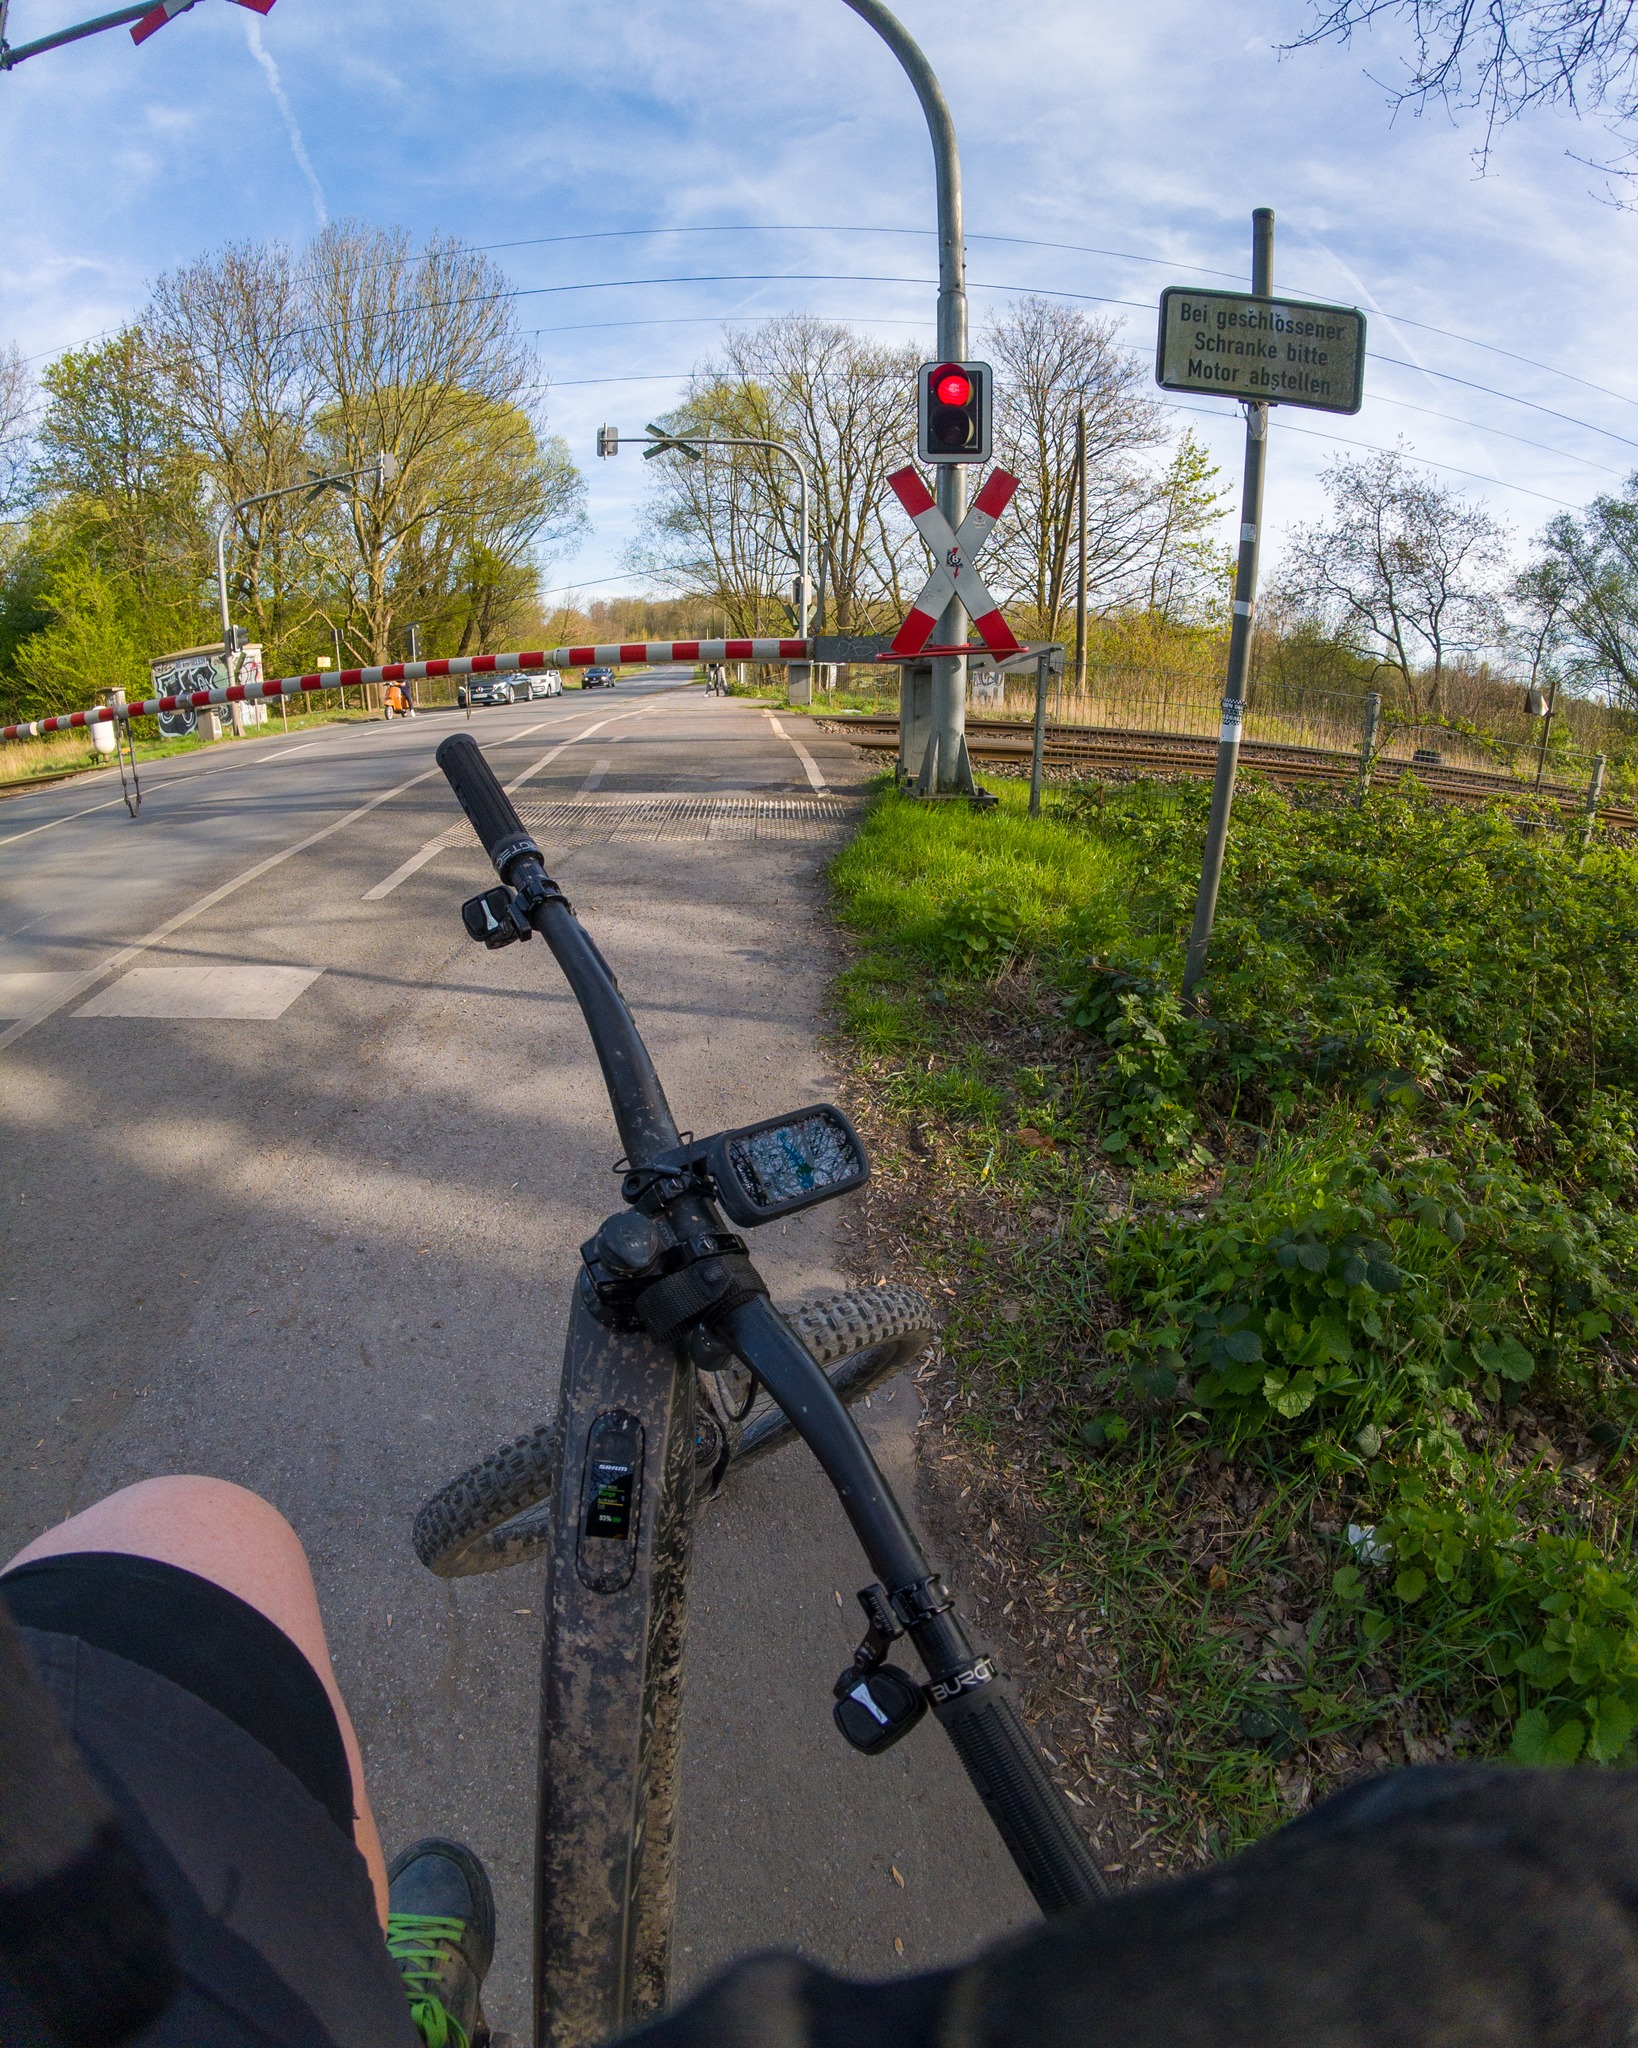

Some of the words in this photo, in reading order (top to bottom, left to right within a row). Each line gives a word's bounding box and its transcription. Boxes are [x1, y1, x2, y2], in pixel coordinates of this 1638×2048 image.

[1181, 303, 1207, 323] Bei
[1217, 310, 1344, 341] geschlossener
[1195, 332, 1277, 359] Schranke
[1287, 342, 1328, 366] bitte
[1188, 358, 1240, 382] Motor
[1251, 366, 1331, 395] abstellen
[598, 1464, 628, 1472] SRAM
